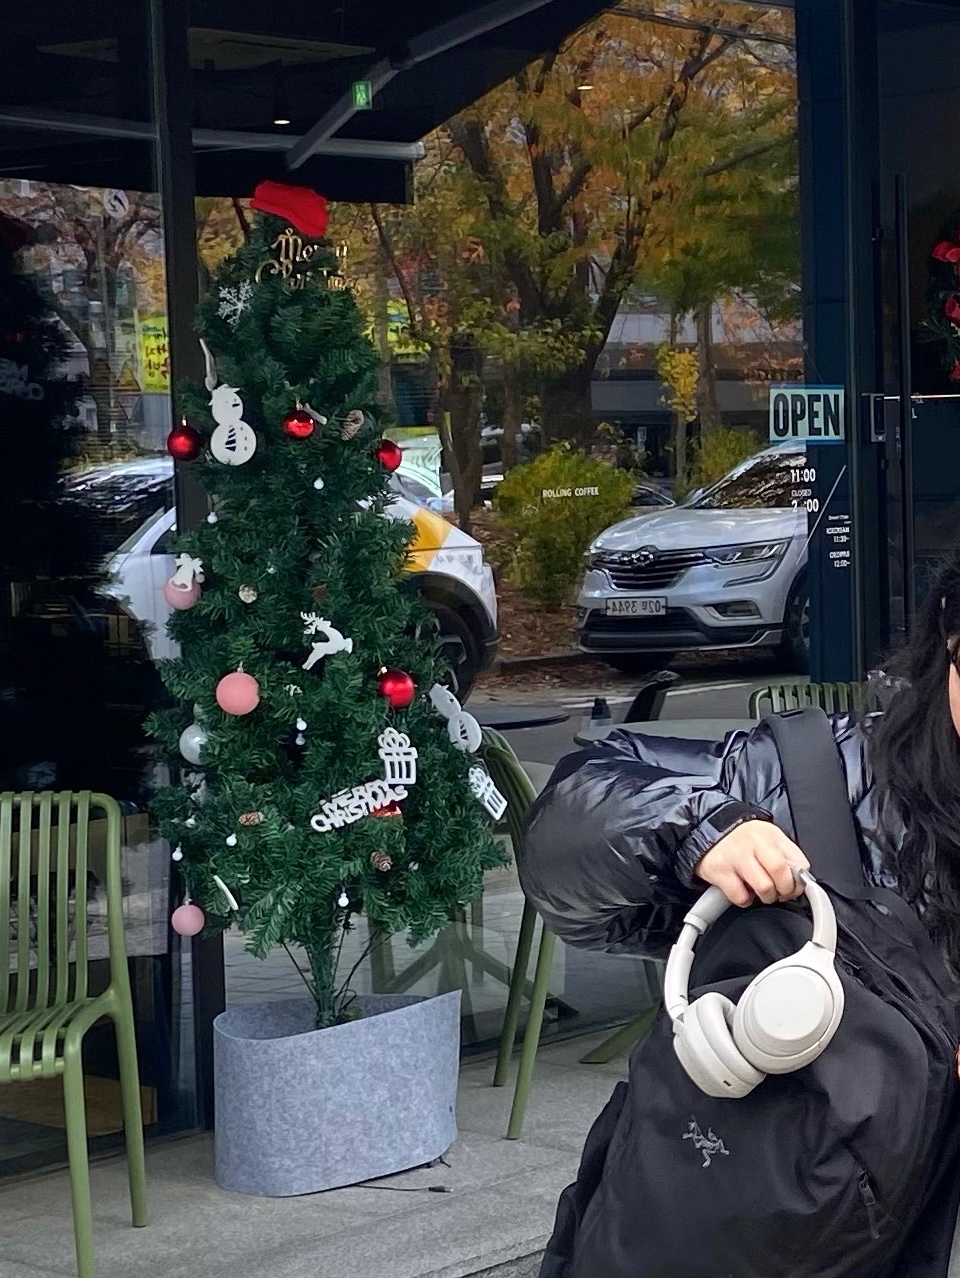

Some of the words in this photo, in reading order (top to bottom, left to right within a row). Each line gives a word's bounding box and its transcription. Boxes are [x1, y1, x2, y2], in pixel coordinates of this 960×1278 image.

[773, 393, 840, 437] OPEN
[790, 468, 816, 483] 11:00
[542, 488, 572, 499] ROLLING
[574, 486, 600, 497] COFFEE
[790, 498, 820, 513] 2:00
[310, 784, 408, 833] CHRISTMAS
[318, 778, 390, 814] MERRY
